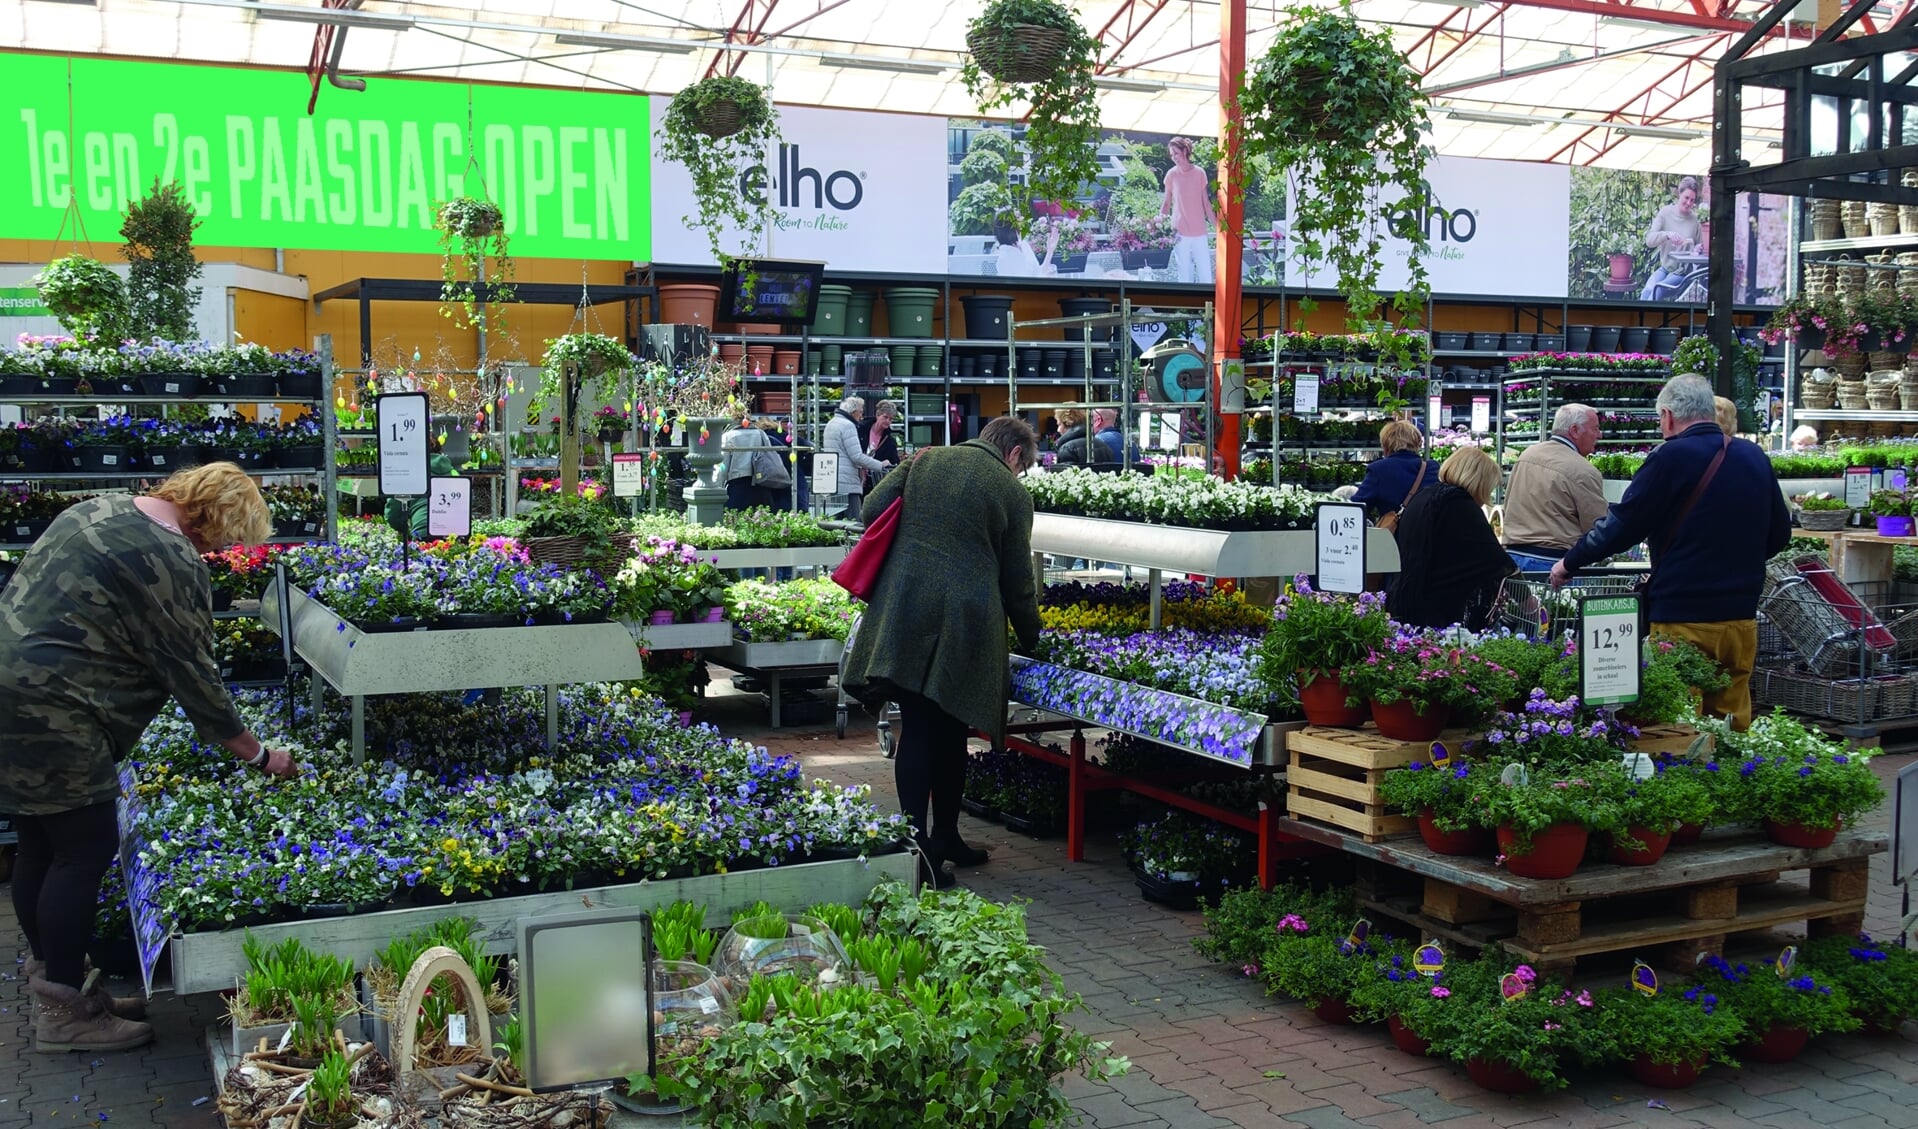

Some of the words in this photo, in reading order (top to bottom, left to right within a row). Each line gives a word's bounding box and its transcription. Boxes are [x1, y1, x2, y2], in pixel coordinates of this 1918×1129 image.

[20, 108, 72, 209] 1e
[84, 131, 141, 212] en
[153, 112, 212, 217] 2e
[225, 115, 465, 230] PAASDAG
[484, 124, 630, 241] OPEN
[740, 143, 863, 211] elho
[814, 212, 849, 231] Nature
[391, 418, 416, 442] 1.99
[438, 491, 462, 507] 3,99
[1330, 517, 1355, 536] 0.85
[1586, 598, 1635, 612] BUITENKANSJE
[1592, 623, 1633, 652] 12,99
